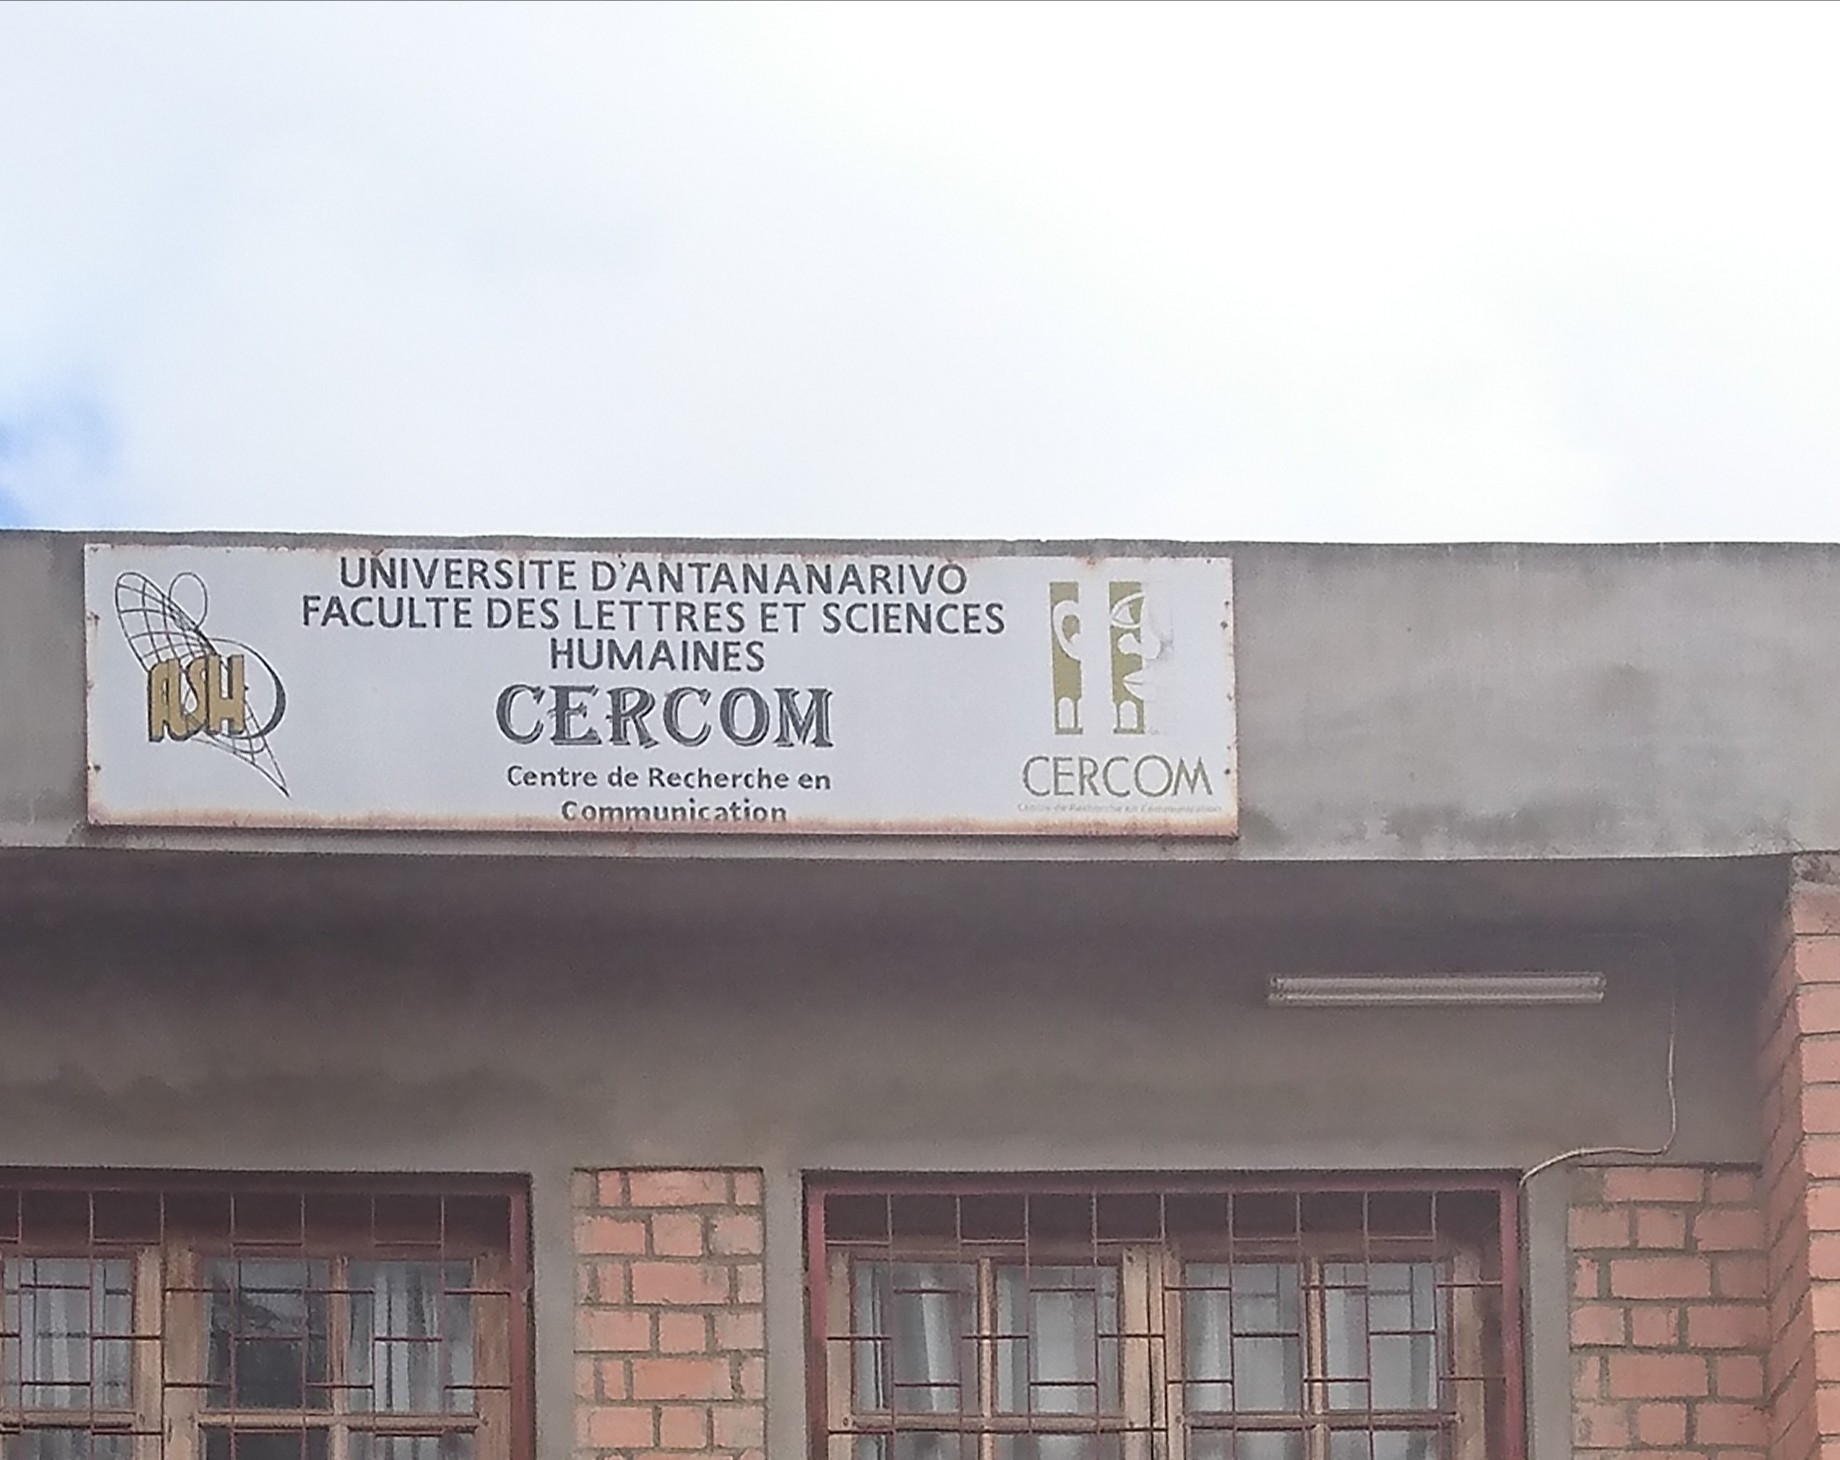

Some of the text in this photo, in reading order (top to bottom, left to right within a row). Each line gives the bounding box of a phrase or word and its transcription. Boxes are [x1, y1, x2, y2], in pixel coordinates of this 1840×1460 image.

[340, 557, 968, 596] UNIVERSITE D'ANTANANARIVO
[302, 595, 1006, 635] FACULTE DES LETTRES ET SCIENCES
[549, 637, 766, 672] HUMAINES
[495, 684, 835, 749] CERCOM
[506, 765, 832, 791] Centre de Recherche en
[1022, 753, 1214, 798] CERCOM
[561, 797, 788, 824] Communication
